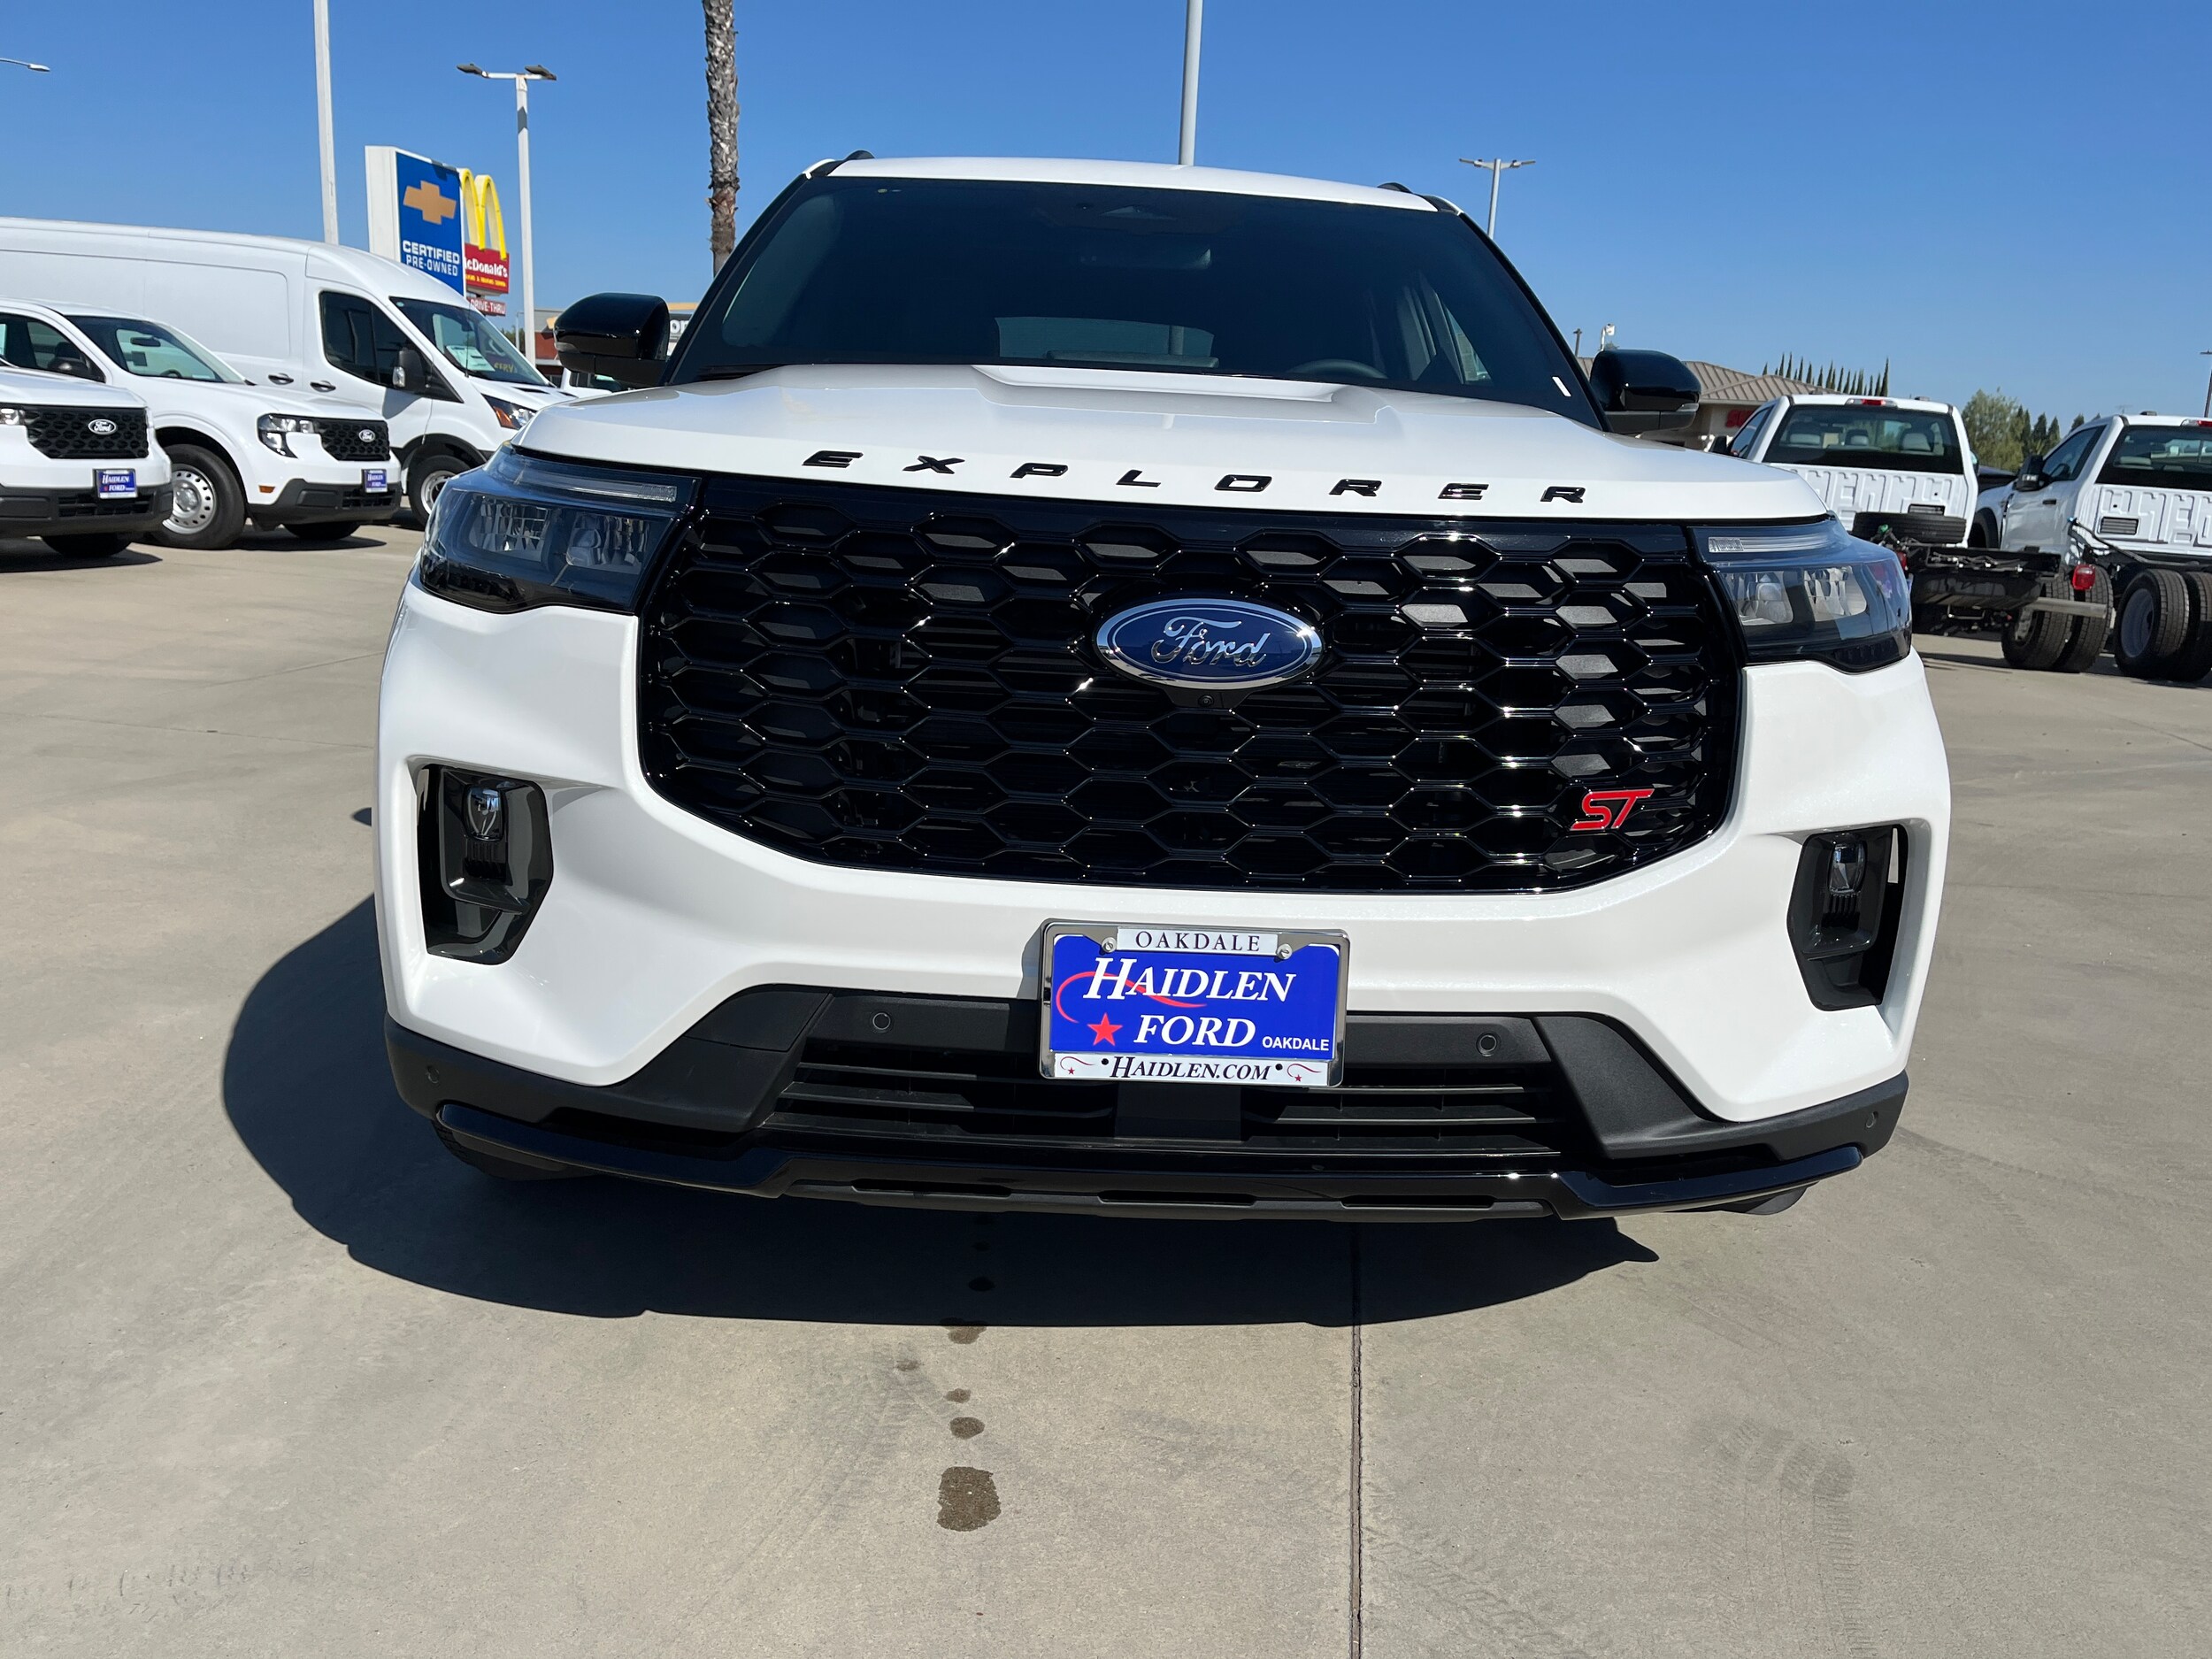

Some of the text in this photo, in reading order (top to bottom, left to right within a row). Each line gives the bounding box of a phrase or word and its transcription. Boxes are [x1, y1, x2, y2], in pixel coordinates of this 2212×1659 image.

[403, 240, 460, 265] CERTIFIED
[405, 254, 458, 276] PRE-OWNED
[465, 257, 508, 278] cDonald's
[802, 450, 1586, 503] EXPLORER
[1151, 616, 1271, 668] Ford
[1570, 788, 1655, 831] ST
[1135, 931, 1261, 953] OAKDALE
[1082, 956, 1296, 1002] HAIDLEN
[1133, 1014, 1256, 1048] FORD
[1262, 1035, 1330, 1052] OAKDALE
[1110, 1056, 1271, 1080] HAIDLEN.COM
